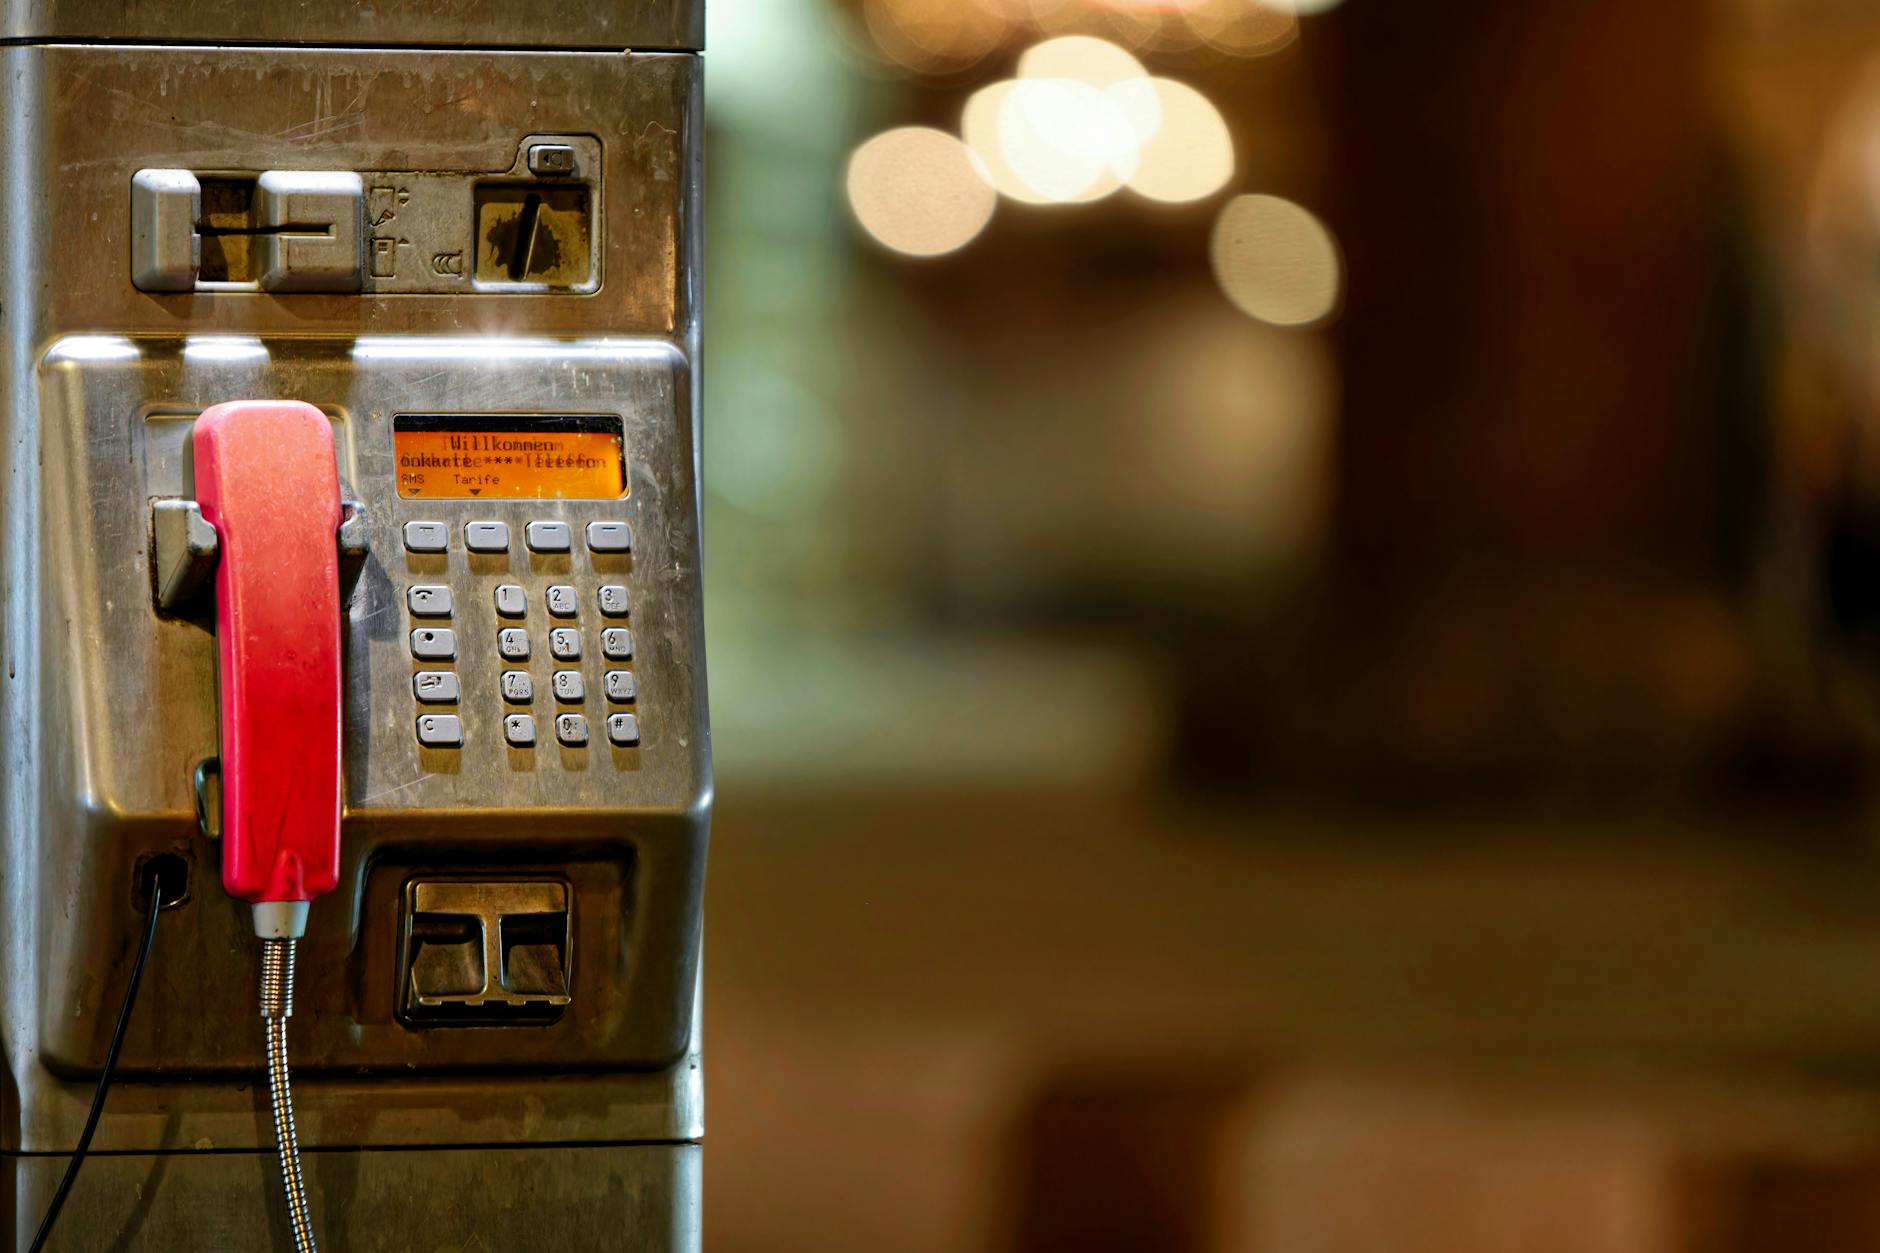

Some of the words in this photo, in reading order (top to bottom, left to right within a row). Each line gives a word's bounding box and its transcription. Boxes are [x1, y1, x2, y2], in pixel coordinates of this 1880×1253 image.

[450, 434, 553, 452] Willkommen
[401, 473, 425, 484] SMS
[453, 474, 500, 485] Tarife
[502, 588, 508, 601] 1
[553, 589, 561, 602] 2
[604, 589, 613, 602] 3
[505, 632, 514, 643] 4
[556, 632, 565, 645] 5
[608, 632, 617, 645] 6
[508, 675, 516, 687] 7
[560, 674, 568, 687] 8
[611, 674, 619, 687] 9
[563, 718, 571, 731] 0
